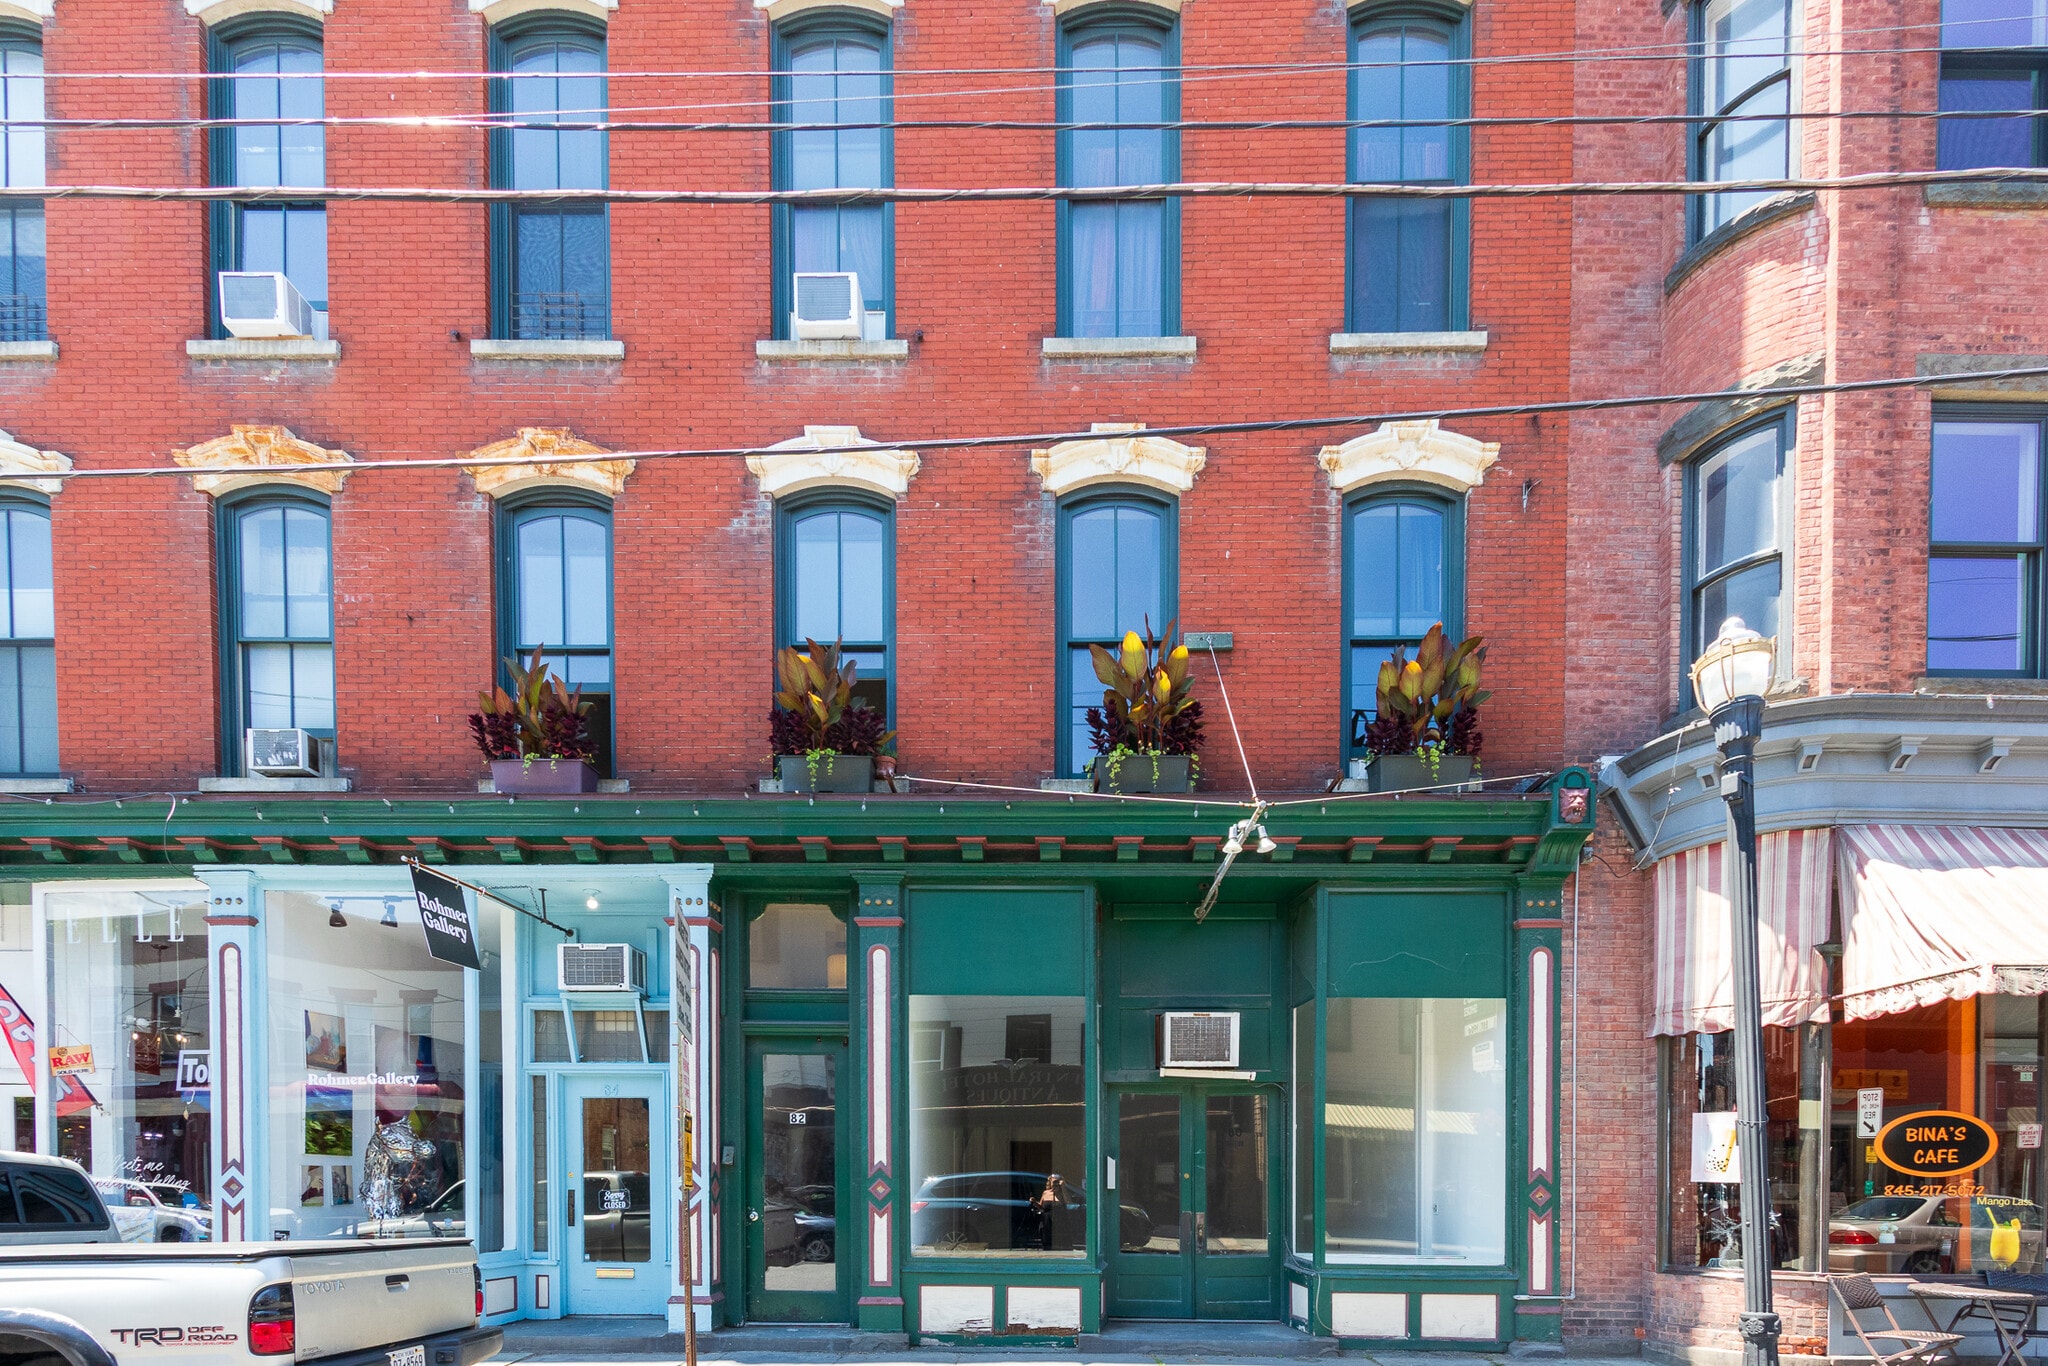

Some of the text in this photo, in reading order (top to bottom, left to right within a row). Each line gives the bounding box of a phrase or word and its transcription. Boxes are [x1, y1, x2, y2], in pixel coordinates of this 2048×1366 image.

[417, 890, 467, 924] Rohmer
[423, 911, 467, 944] Gallery
[51, 1052, 90, 1067] RAW
[308, 1072, 420, 1087] Rohmer Gallery
[790, 1113, 805, 1124] 82
[1905, 1126, 1967, 1142] BINA'S
[1913, 1149, 1960, 1164] CAFE
[1883, 1184, 1985, 1197] 845-217-5072
[603, 1200, 626, 1209] CLOSED
[1976, 1196, 2011, 1207] Mango
[299, 1279, 346, 1295] TOYOTA
[110, 1326, 225, 1347] TRD OFF
[187, 1334, 239, 1342] ROAD
